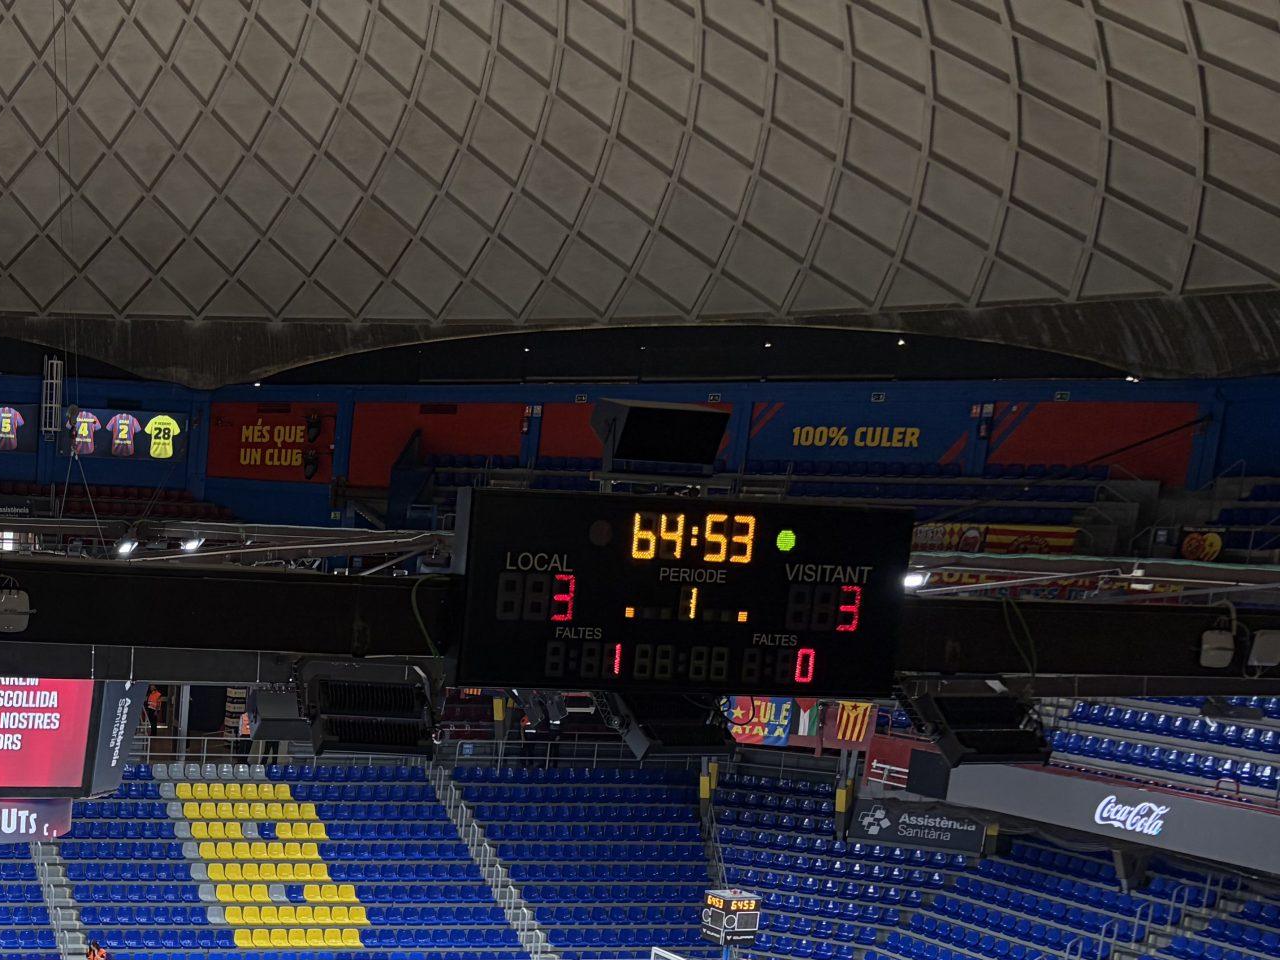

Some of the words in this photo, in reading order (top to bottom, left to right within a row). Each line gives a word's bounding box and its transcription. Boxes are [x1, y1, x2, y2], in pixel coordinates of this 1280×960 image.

[1, 418, 11, 433] 5
[78, 421, 89, 437] 4
[119, 425, 129, 439] 2
[154, 427, 172, 441] 28
[241, 417, 270, 442] MÉS
[274, 425, 306, 447] QUE
[792, 426, 849, 447] 100%
[853, 426, 920, 448] CULER
[240, 448, 260, 466] UN
[265, 448, 303, 466] CLUB
[632, 512, 756, 563] 64:53
[506, 552, 573, 572] LOCAL
[659, 567, 727, 583] PERIODE
[785, 563, 872, 584] VISITANT
[551, 574, 576, 621] 3
[689, 587, 698, 619] 1
[836, 585, 862, 632] 3
[556, 627, 602, 639] FALTES
[753, 633, 798, 646] FALTES
[795, 648, 815, 683] 0
[0, 713, 61, 729] NOSTRES
[899, 813, 976, 831] Assistència
[1094, 795, 1171, 835] Coca-Cola
[898, 824, 951, 840] Sanitària
